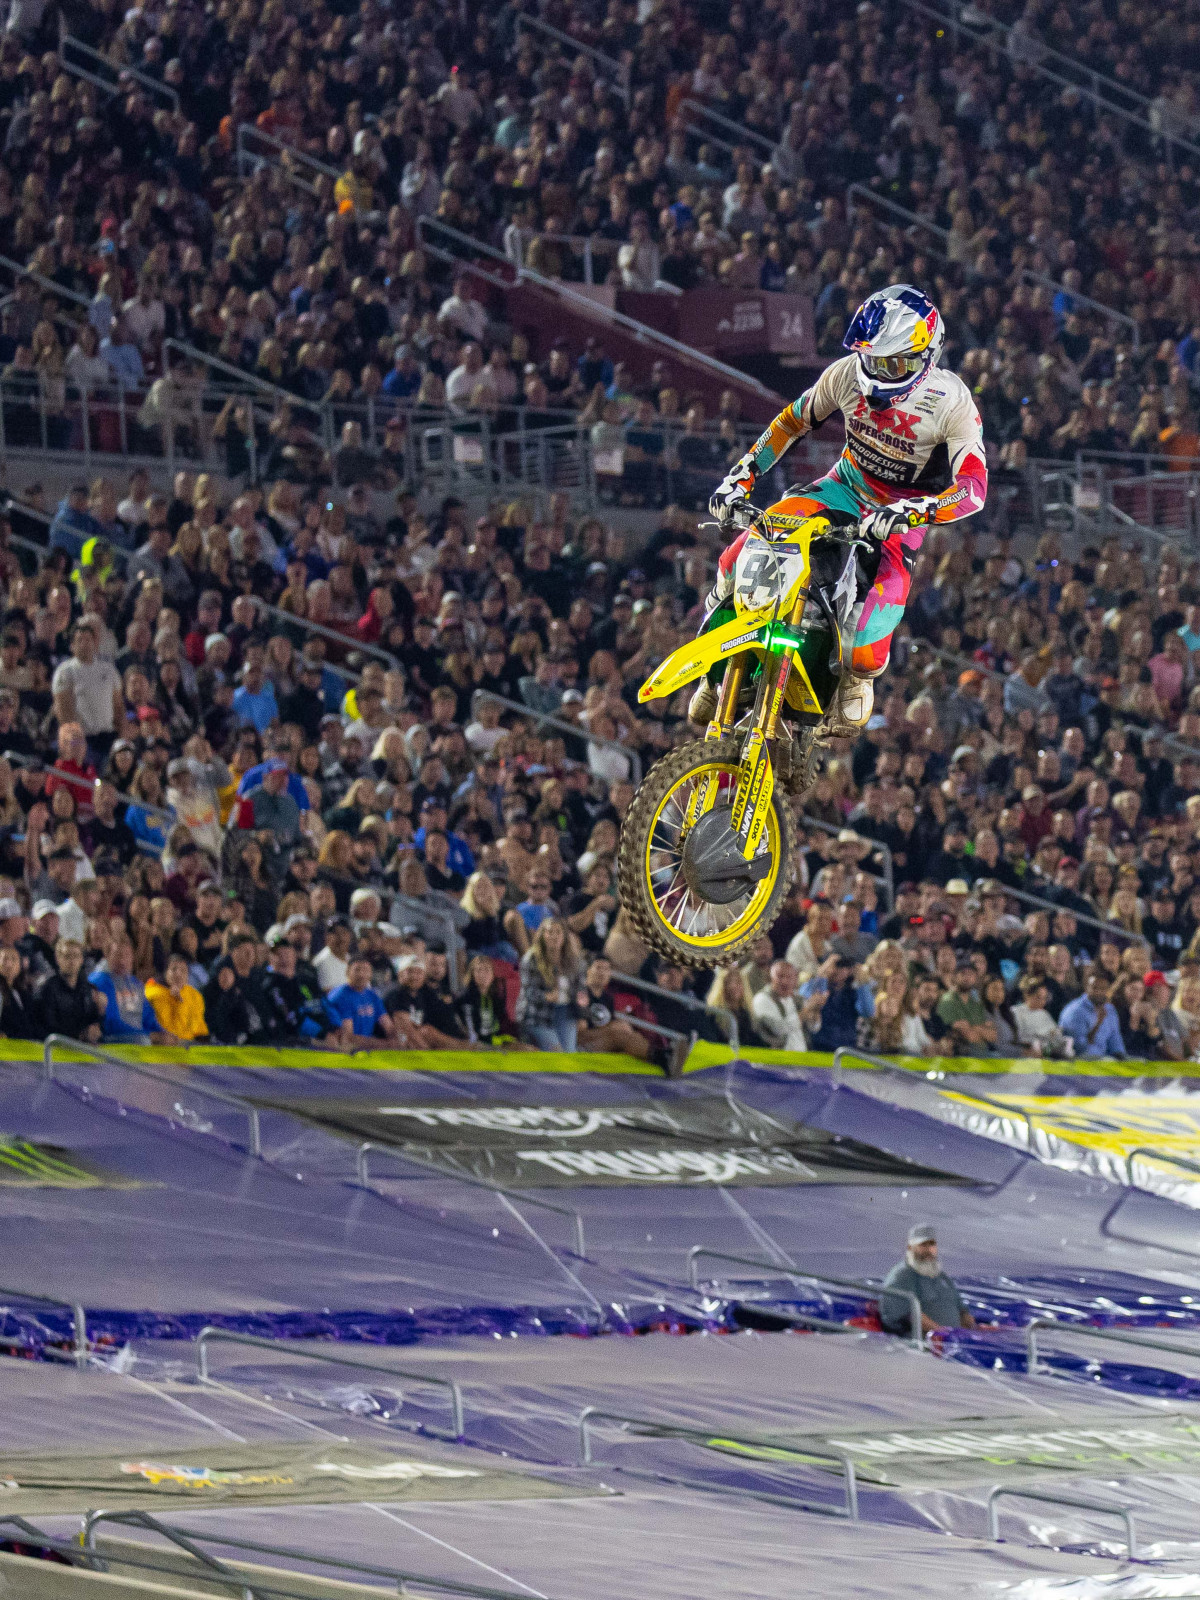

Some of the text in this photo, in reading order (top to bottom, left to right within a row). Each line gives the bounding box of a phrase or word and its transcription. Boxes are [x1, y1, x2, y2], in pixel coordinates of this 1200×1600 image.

[848, 417, 916, 456] SUPERCROSS
[848, 437, 907, 472] PROGRESSIVE
[737, 553, 788, 597] 94
[720, 629, 759, 652] PROGRESSIVE
[731, 760, 752, 831] DUNLOP
